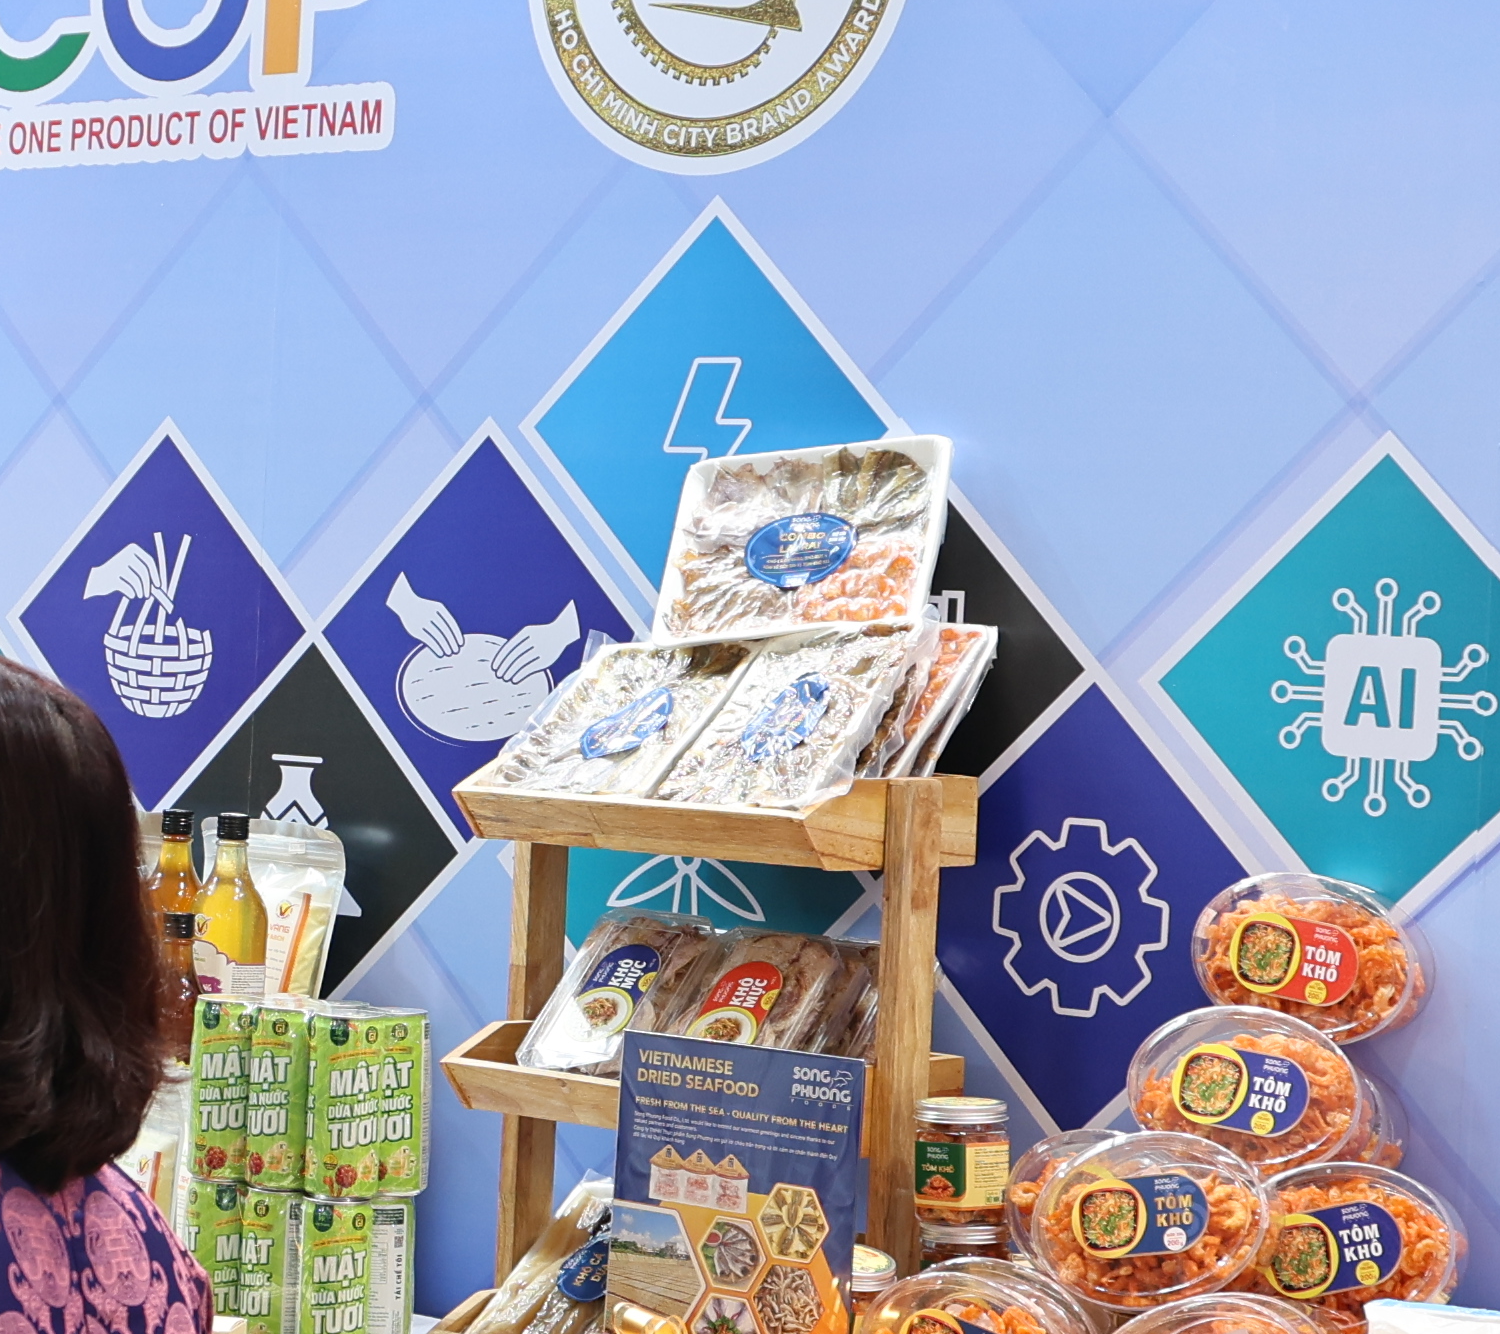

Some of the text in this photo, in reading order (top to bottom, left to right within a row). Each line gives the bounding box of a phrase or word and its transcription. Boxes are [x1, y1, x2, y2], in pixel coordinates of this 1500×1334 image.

[552, 7, 580, 52] HO
[571, 50, 606, 97] CHI
[602, 87, 658, 138] MINH
[662, 122, 719, 148] CITY
[726, 87, 812, 147] BRAND
[8, 119, 63, 156] ONE
[70, 111, 202, 152] PRODUCT
[208, 108, 247, 145] OF
[253, 99, 383, 141] VIETNAM
[1344, 666, 1416, 730] AI
[1305, 944, 1342, 966] TÔM
[1302, 962, 1338, 983] KHÔ
[729, 977, 754, 1006] KHÔ
[742, 978, 768, 1009] MỰC
[639, 1048, 733, 1076] VIETNAMESE
[637, 1067, 759, 1098] DRIED SEAFOOD
[635, 1095, 849, 1134] FRESH FROM THE SEA QUALITY FROM THE HEART
[313, 1248, 367, 1287] MẬT
[338, 1284, 365, 1303] NƯỚC
